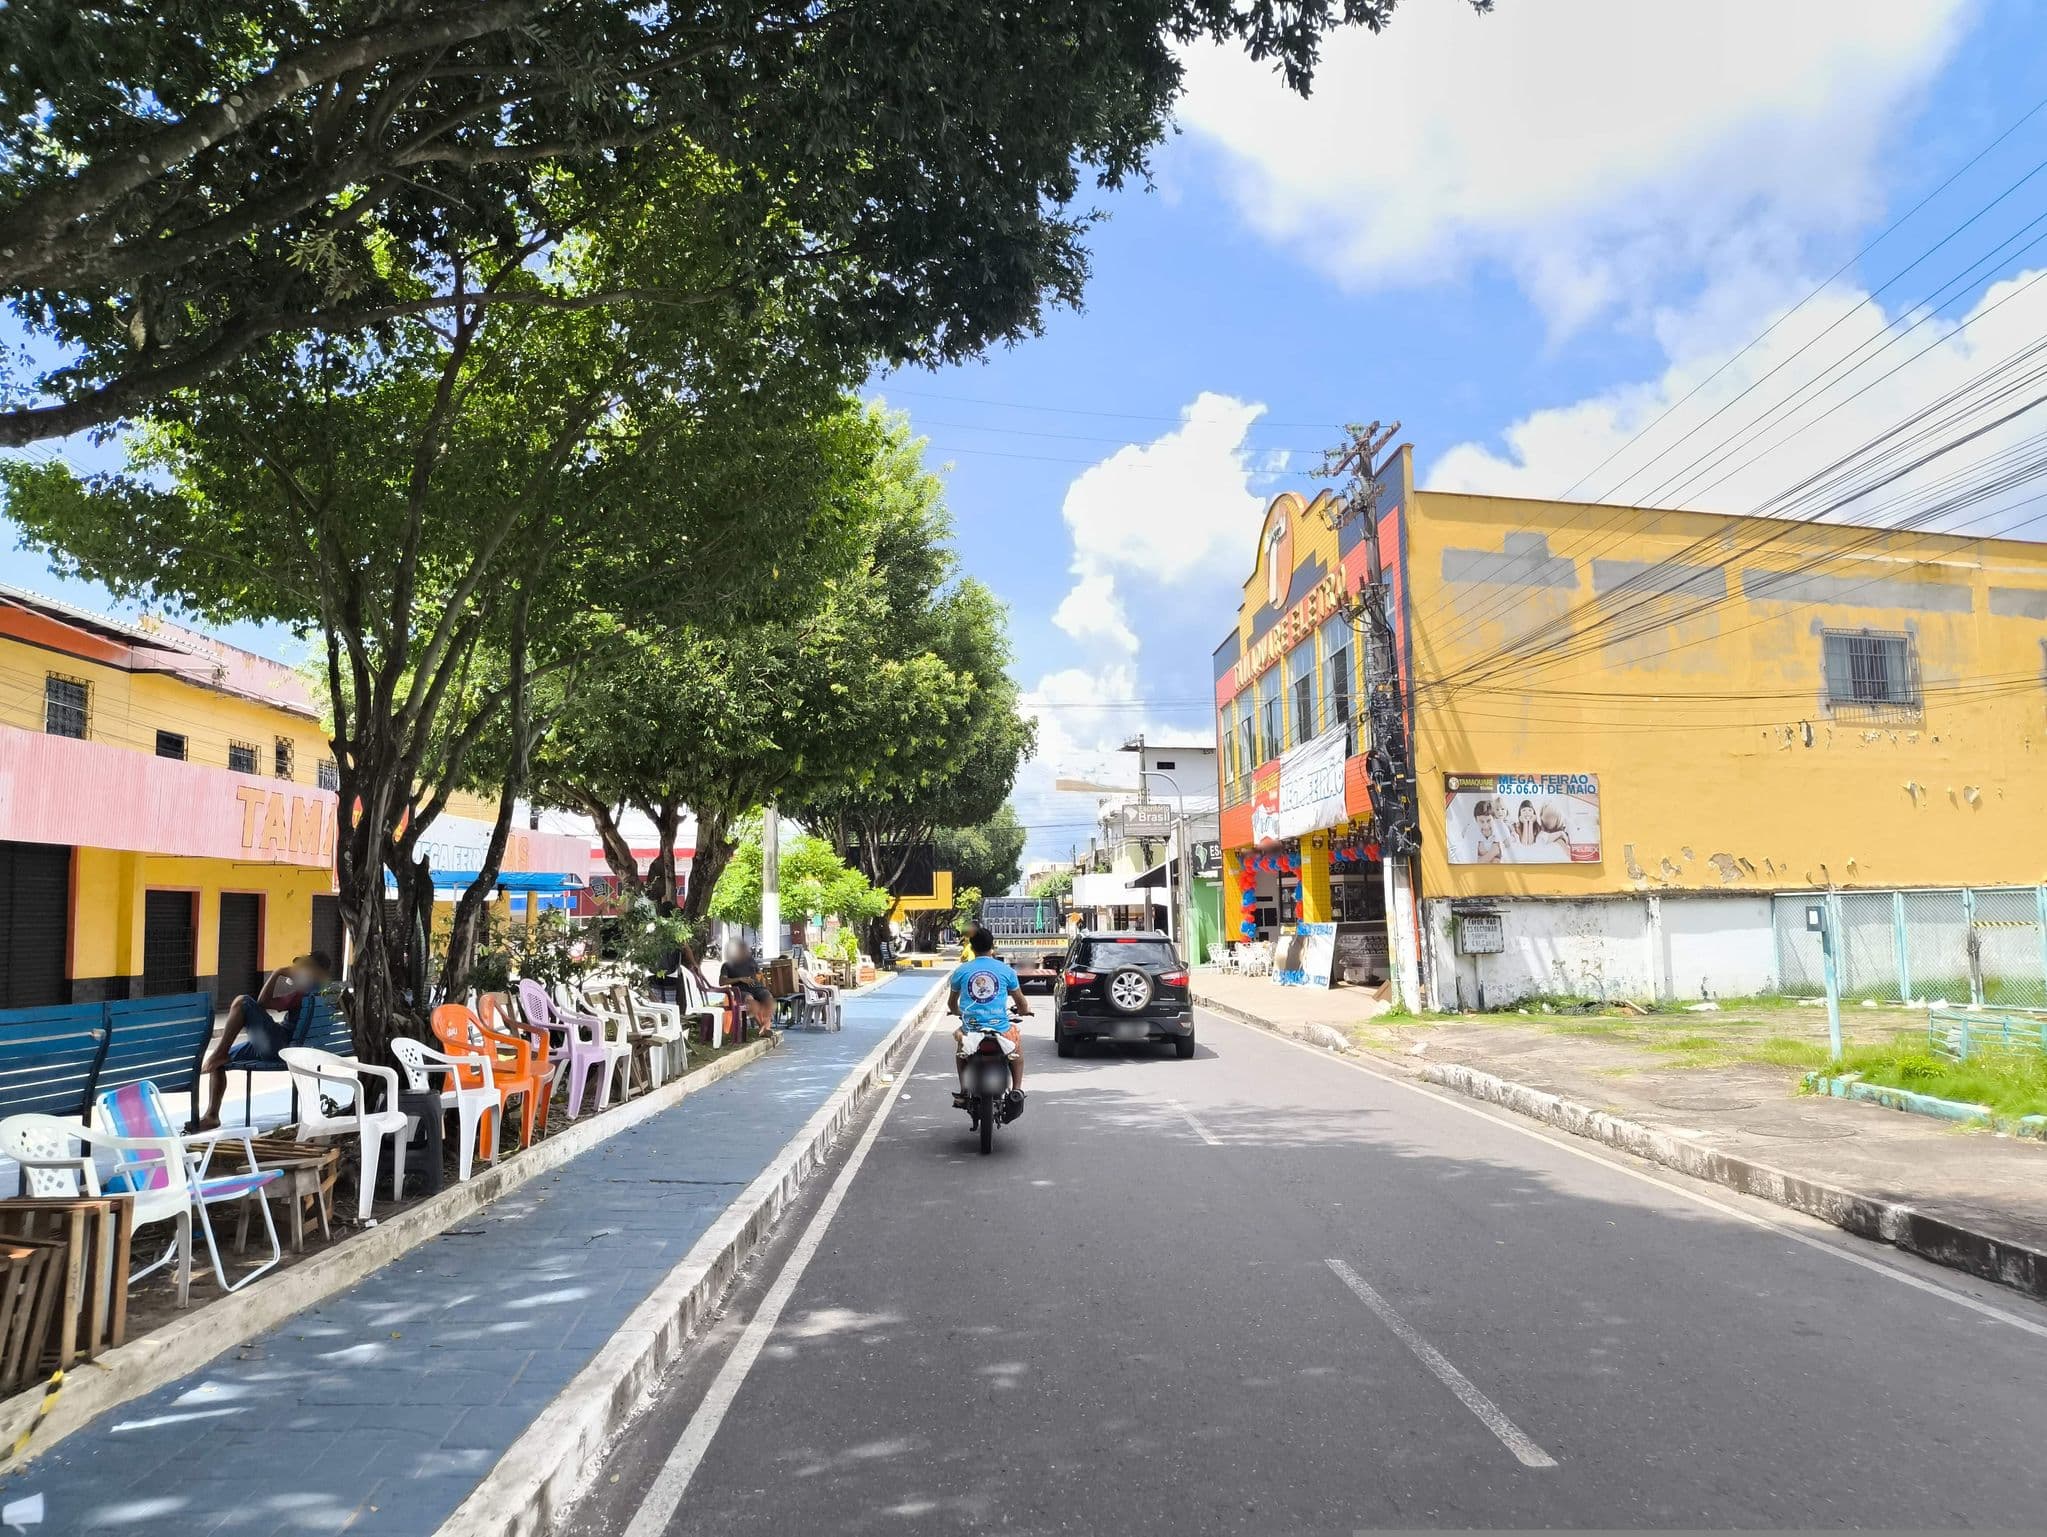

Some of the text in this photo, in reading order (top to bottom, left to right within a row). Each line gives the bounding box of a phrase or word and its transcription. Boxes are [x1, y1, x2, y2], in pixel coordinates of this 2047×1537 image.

[1498, 775, 1535, 785] MEGA
[1547, 785, 1563, 795] DE
[1567, 785, 1596, 795] MAIO
[1139, 812, 1170, 822] Brasil
